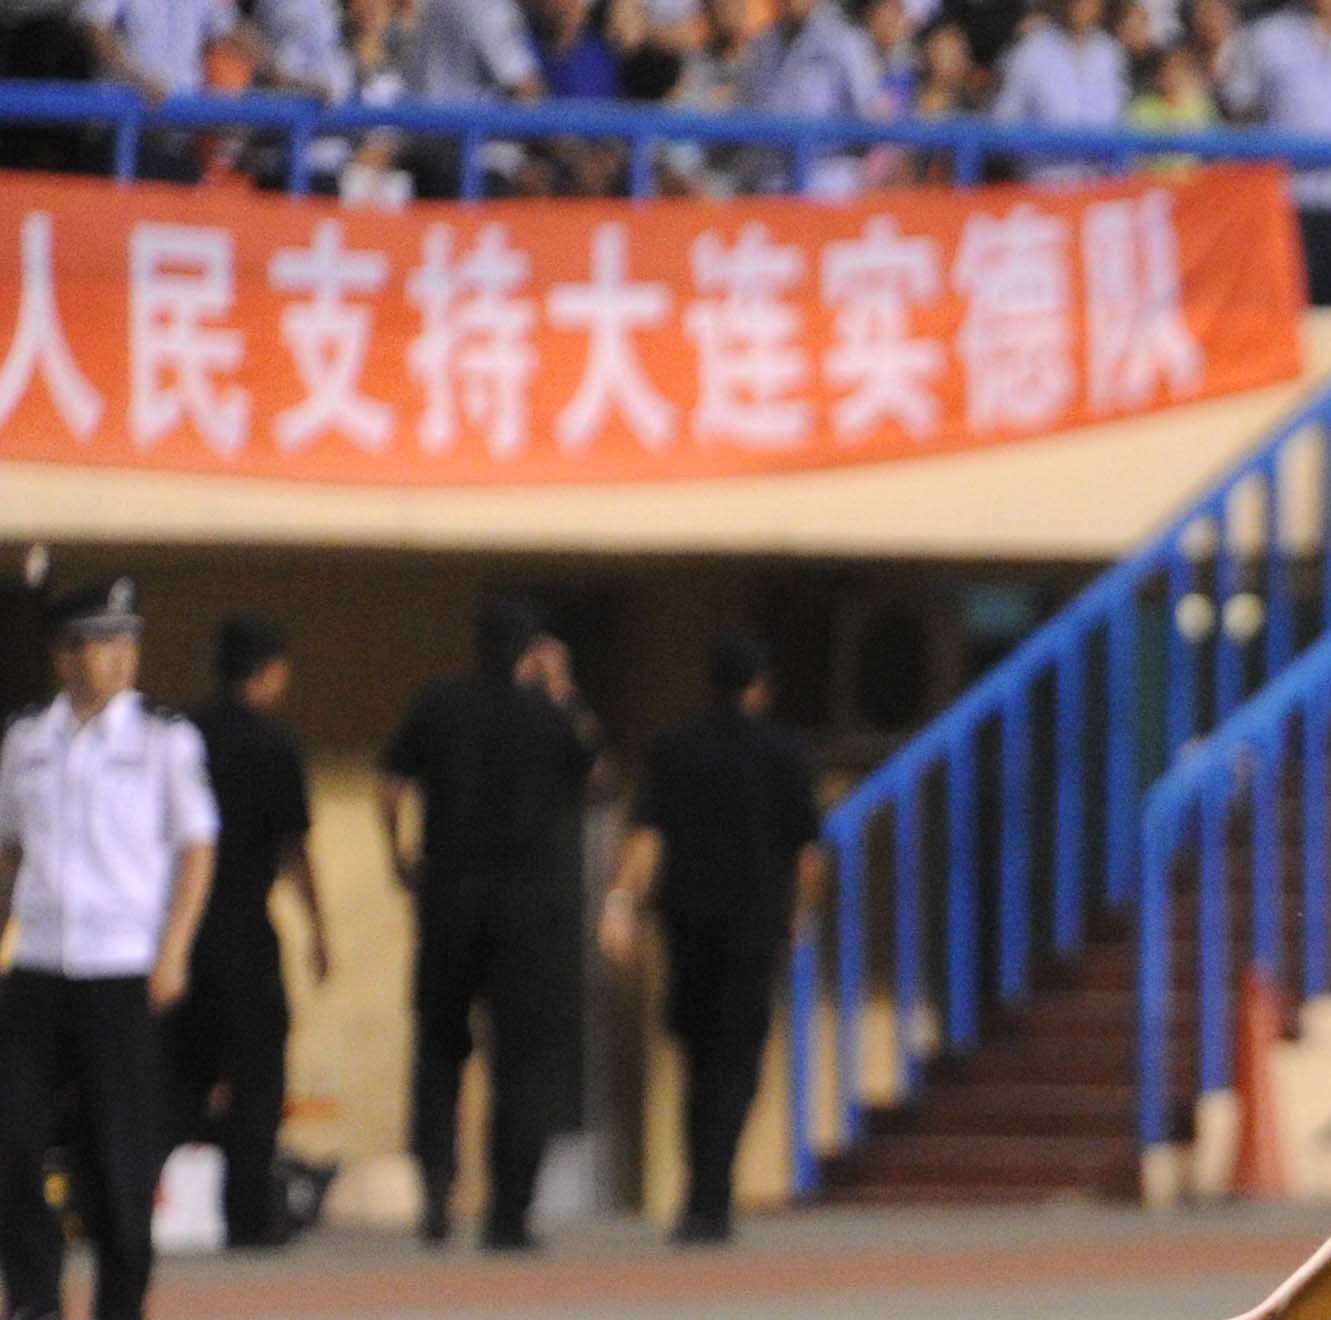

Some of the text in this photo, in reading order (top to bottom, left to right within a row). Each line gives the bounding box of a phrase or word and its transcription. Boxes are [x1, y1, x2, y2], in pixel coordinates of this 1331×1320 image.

[0, 190, 1204, 459] 人民支持大连实德队
